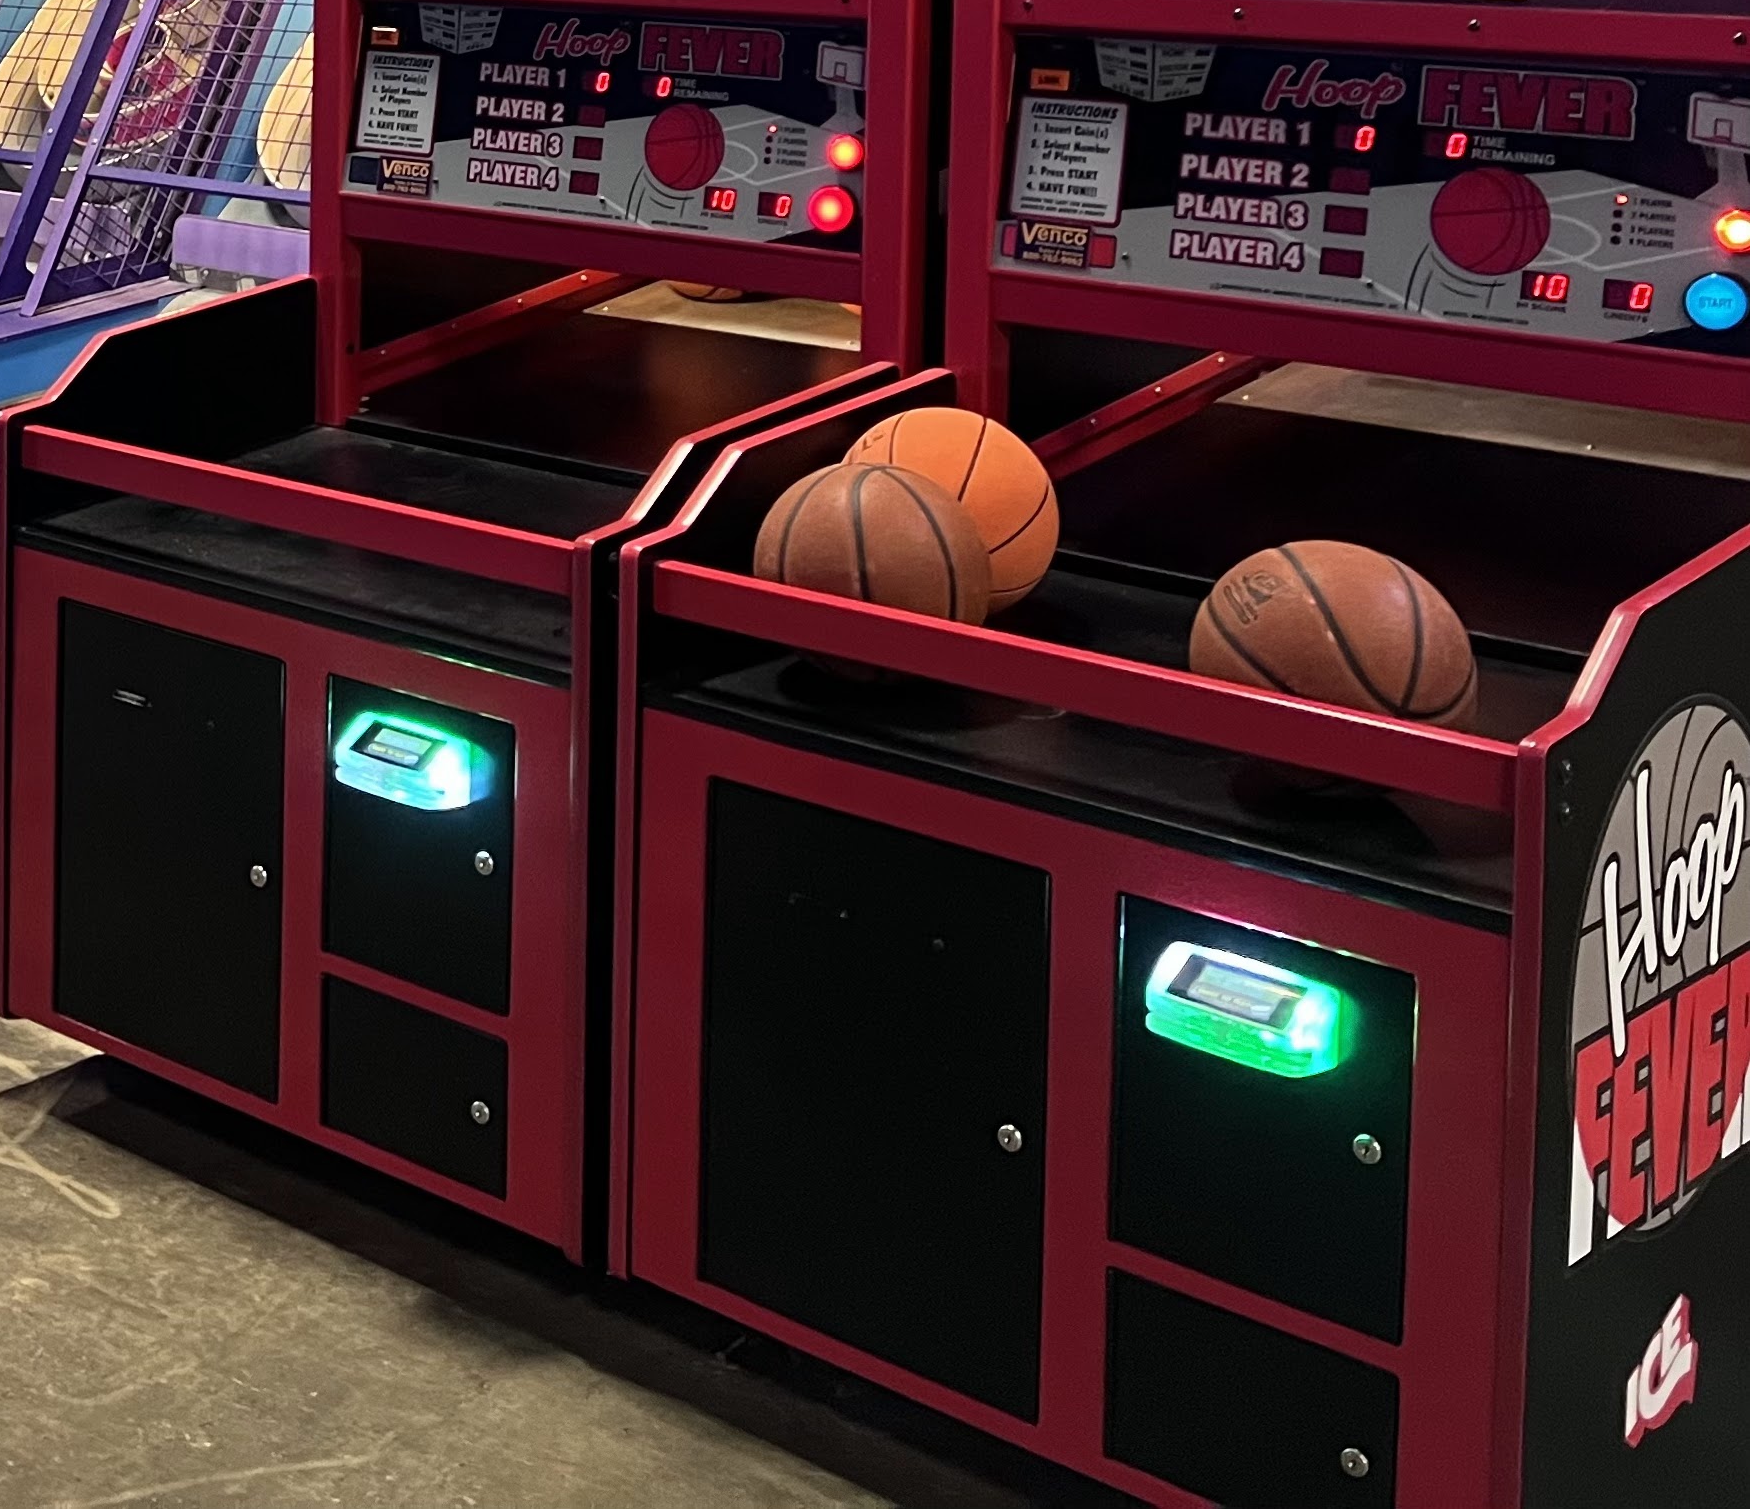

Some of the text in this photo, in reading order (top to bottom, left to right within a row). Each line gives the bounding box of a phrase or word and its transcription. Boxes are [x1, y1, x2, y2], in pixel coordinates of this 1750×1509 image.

[372, 55, 434, 69] INSTRUCTIONS
[533, 17, 631, 66] Hoop
[637, 21, 784, 81] FEVER
[479, 62, 567, 88] PLAYER 1
[595, 72, 610, 92] 0
[656, 76, 671, 97] 0
[476, 96, 565, 123] PLAYER 2
[1031, 102, 1119, 120] INSTRUCTIONS
[1261, 58, 1407, 120] Hoop
[1416, 64, 1639, 141] FEVER
[472, 128, 561, 155] PLAYER 3
[1184, 112, 1312, 147] PLAYER 1
[1354, 125, 1376, 152] 0
[1472, 135, 1506, 150] TIME
[1445, 132, 1469, 160] 0
[1471, 147, 1556, 166] REMAINING
[382, 158, 430, 178] Venco
[469, 160, 558, 189] PLAYER 4
[1067, 169, 1098, 180] START
[1180, 154, 1310, 189] PLAYER 2
[711, 189, 736, 211] 10
[1039, 182, 1064, 194] HAVE
[775, 195, 792, 217] 0
[1176, 193, 1305, 229] PLAYER 3
[1022, 221, 1088, 247] Venco
[1172, 233, 1302, 270] PLAYER 4
[1533, 274, 1568, 300] 10
[1629, 283, 1654, 310] 0
[1699, 296, 1733, 310] START
[1603, 767, 1745, 1058] Hoop
[1624, 1294, 1698, 1444] ICE
